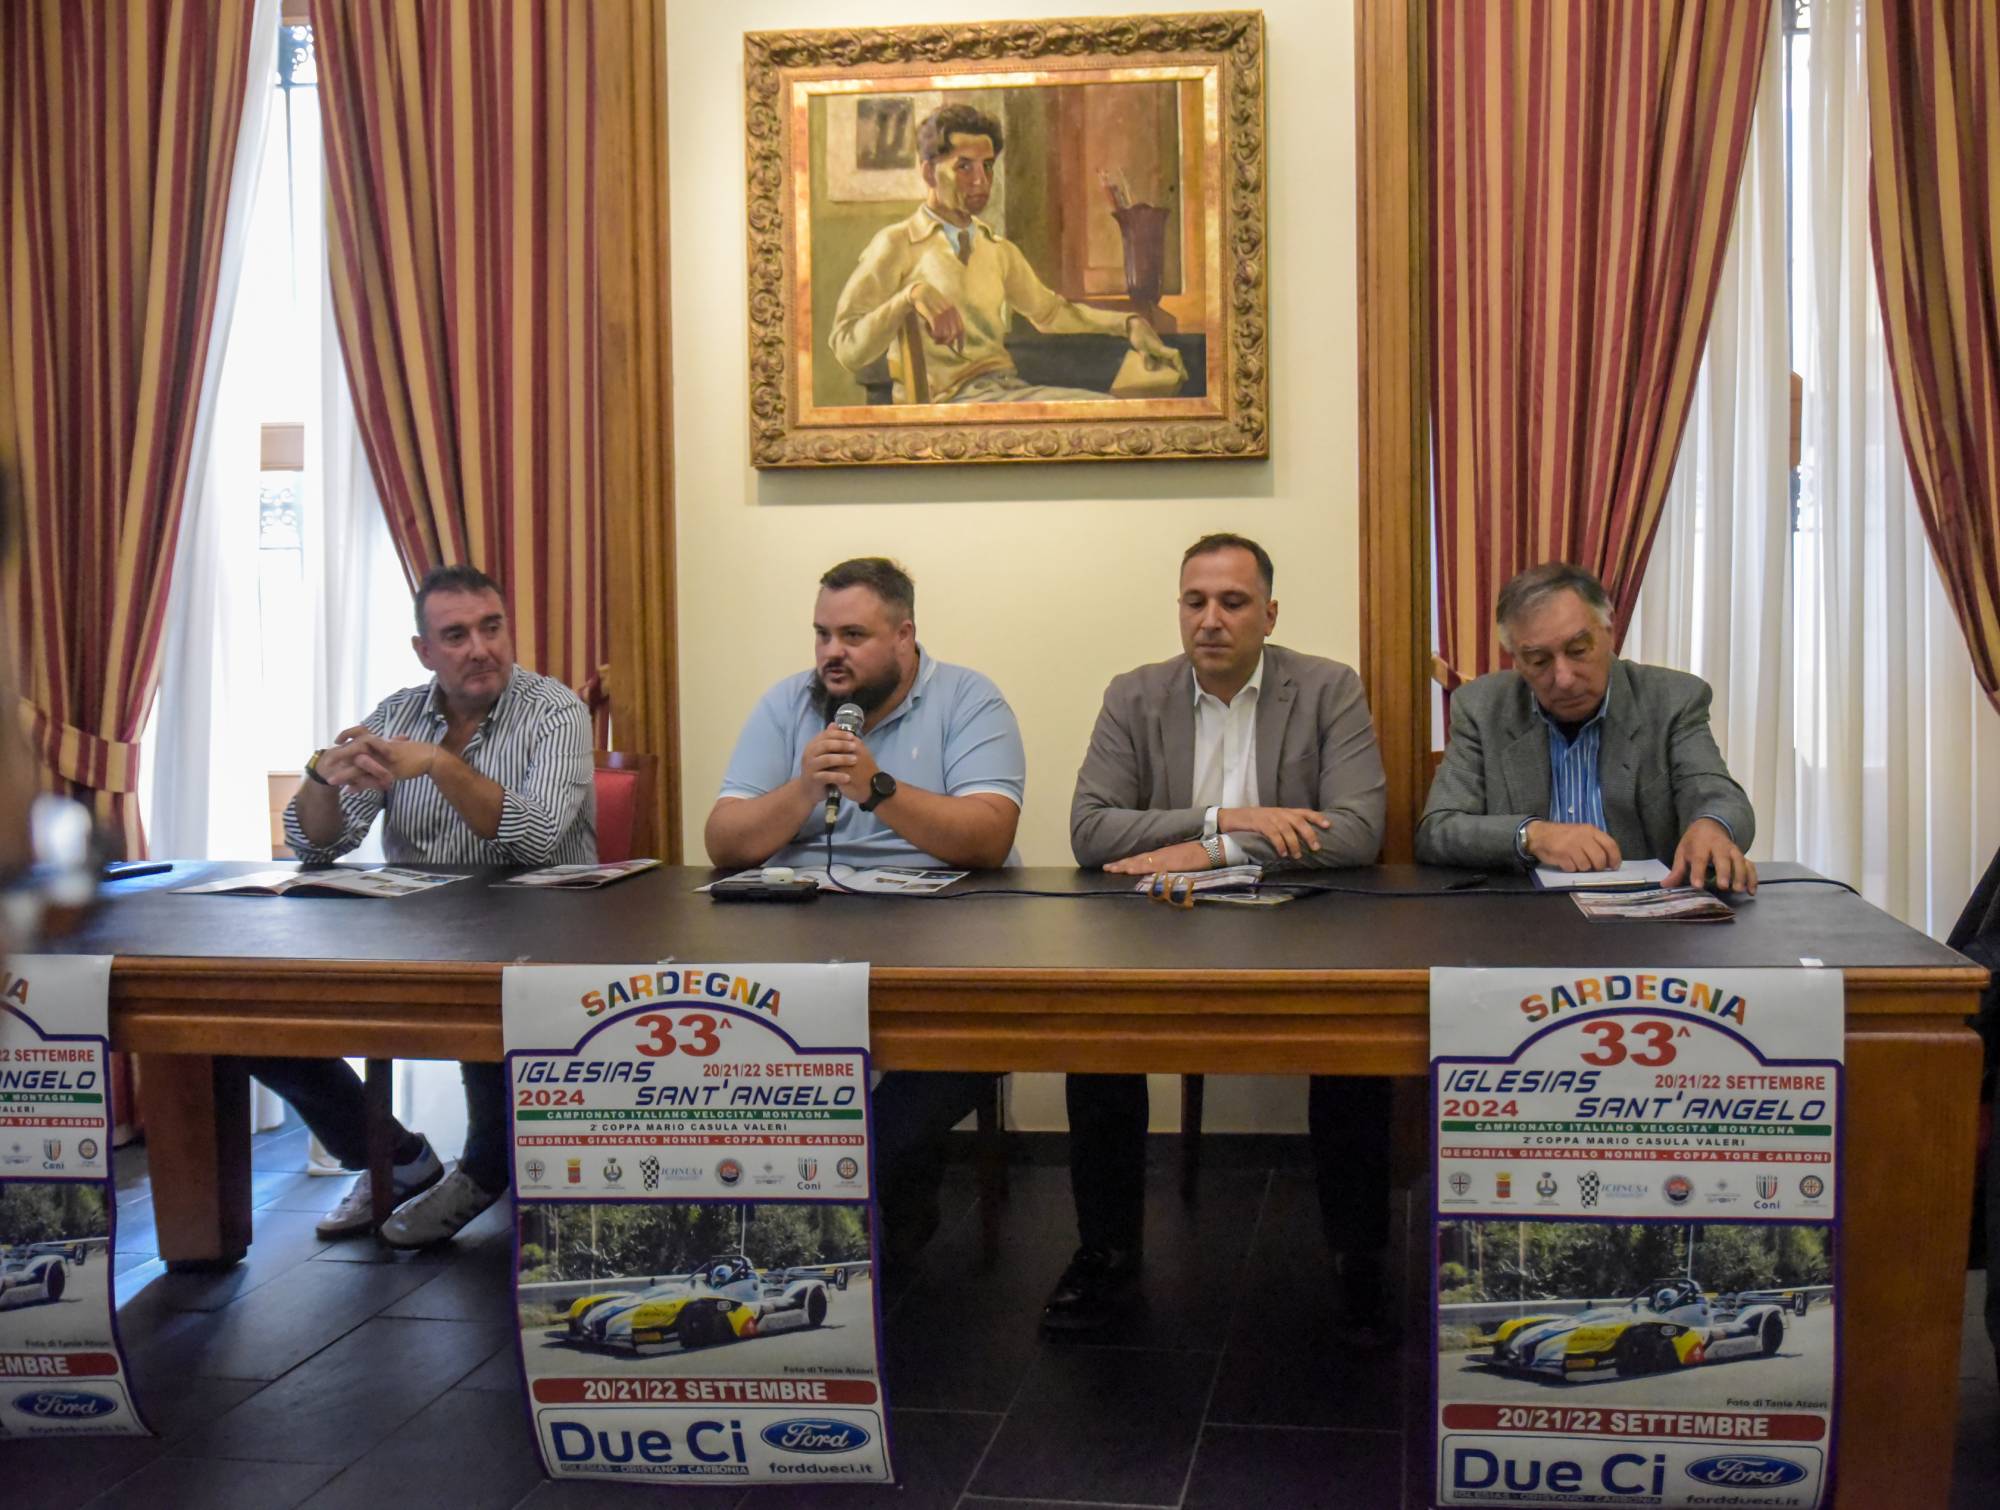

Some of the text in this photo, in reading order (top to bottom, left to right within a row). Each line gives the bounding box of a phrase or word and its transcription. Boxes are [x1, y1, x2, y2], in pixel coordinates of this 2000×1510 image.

[580, 970, 781, 1018] SARDEGNA
[1520, 974, 1747, 1026] SARDEGNA
[15, 1049, 95, 1062] SETTEMBRE
[518, 1061, 655, 1084] IGLESIAS
[703, 1063, 854, 1077] 20/21/22 SETTEMBRE
[0, 1070, 96, 1089] NGELO
[1443, 1070, 1602, 1093] IGLESIAS
[1655, 1075, 1825, 1091] 20/21/22 SETTEMBRE
[518, 1089, 585, 1106] 2024
[635, 1079, 856, 1105] SANT'ANGELO
[1443, 1100, 1519, 1117] 2024
[1575, 1091, 1826, 1121] SANT'ANGELO
[547, 1111, 626, 1120] CAMPIONATO
[631, 1111, 689, 1120] ITALIANO
[763, 1110, 830, 1119] MONTAGNA
[602, 1124, 642, 1132] COPPA
[646, 1124, 685, 1132] MARIO
[690, 1123, 738, 1132] CASULA
[743, 1123, 788, 1132] VALERI
[1475, 1122, 1563, 1132] CAMPIONATO
[1569, 1123, 1634, 1133] ITALIANO
[1718, 1125, 1795, 1135] MONTAGNA
[518, 1136, 582, 1145] MEMORIAL
[588, 1136, 657, 1145] GIANCARLO
[662, 1136, 710, 1145] NONNIS
[724, 1136, 765, 1145] COPPA
[770, 1136, 802, 1145] TORE
[807, 1136, 862, 1145] CARBONI
[1536, 1136, 1580, 1145] COPPA
[1586, 1137, 1630, 1145] MARIO
[1636, 1137, 1690, 1146] CASULA
[1696, 1138, 1745, 1146] VALERI
[1441, 1149, 1513, 1158] MEMORIAL
[1519, 1149, 1598, 1159] GIANCARLO
[1604, 1150, 1658, 1160] NONNIS
[1673, 1152, 1718, 1161] COPPA
[1724, 1153, 1760, 1162] TORE
[1765, 1153, 1829, 1163] CARBONI
[797, 1181, 821, 1191] Coni
[1753, 1200, 1780, 1210] Coni
[583, 1380, 828, 1401] 20/21/22 SETTEMBRE
[34, 1394, 97, 1414] Ford
[1497, 1408, 1769, 1437] 20/21/22 SETTEMBRE
[550, 1420, 747, 1463] Due Ci
[782, 1422, 850, 1449] Ford
[769, 1462, 874, 1475] forddueci.it
[1454, 1448, 1665, 1495] Due Ci
[1708, 1458, 1783, 1485] Ford
[1686, 1494, 1800, 1507] forddueci.it
